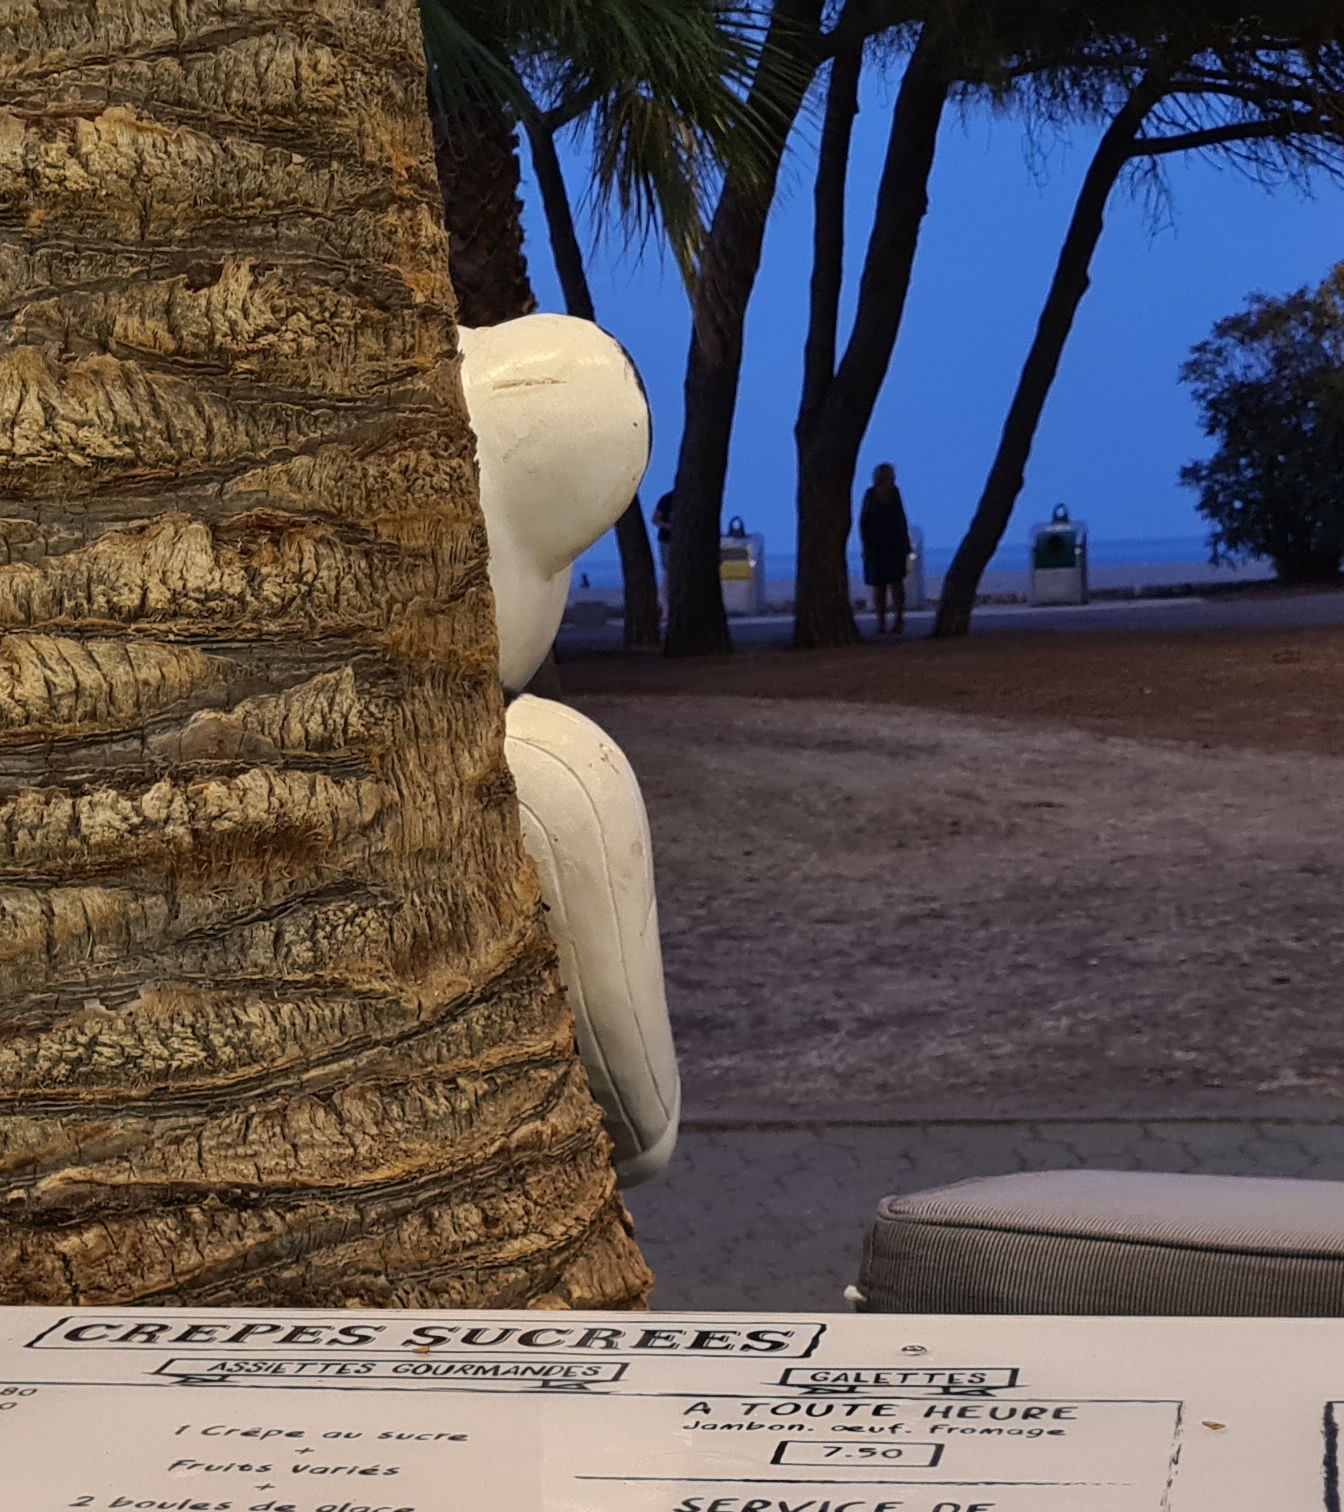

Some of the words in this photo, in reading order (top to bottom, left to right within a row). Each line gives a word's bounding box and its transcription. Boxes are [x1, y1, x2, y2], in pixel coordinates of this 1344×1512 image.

[63, 1322, 387, 1346] CREPES
[400, 1327, 796, 1353] SUCREES
[391, 1363, 602, 1378] GOURMANDES
[810, 1371, 987, 1385] GALETTES
[741, 1402, 897, 1418] TOUTE
[923, 1404, 1078, 1421] HEURE
[174, 1424, 191, 1436] 1
[200, 1425, 305, 1441] Crêpe
[321, 1431, 363, 1439] au
[377, 1431, 468, 1442] sucre
[823, 1445, 903, 1459] 7.50
[167, 1459, 273, 1473] Fruits
[68, 1495, 95, 1508] 2
[108, 1496, 233, 1511] boules
[248, 1500, 296, 1512] de
